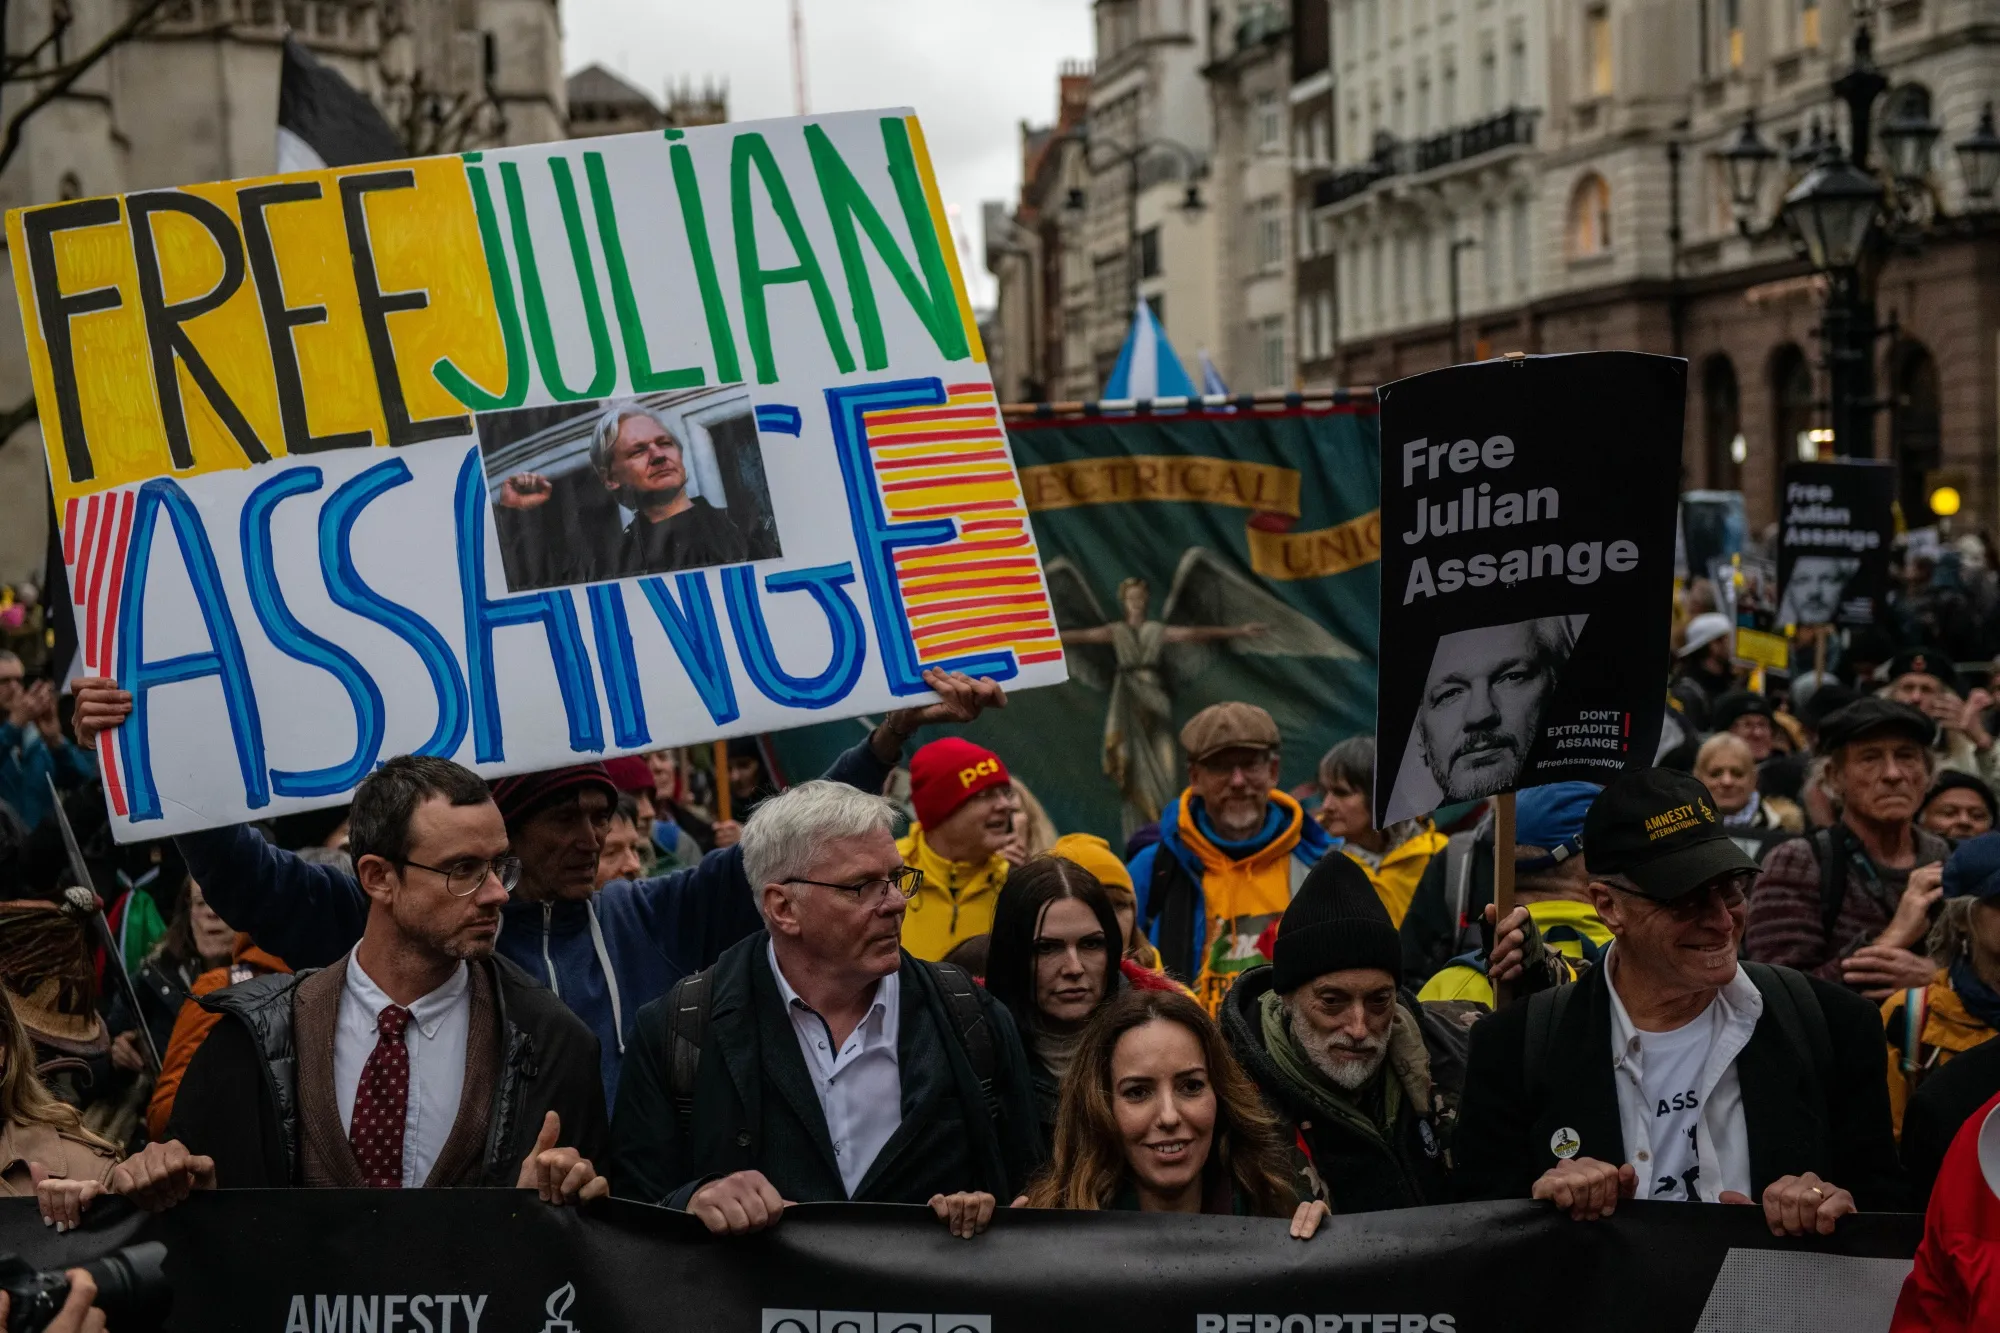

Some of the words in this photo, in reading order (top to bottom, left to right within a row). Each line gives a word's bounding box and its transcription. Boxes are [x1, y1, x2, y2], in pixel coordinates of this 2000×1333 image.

[24, 169, 473, 483] FREE
[1403, 434, 1515, 488] Free
[1036, 460, 1279, 506] ECTRICAL
[1787, 483, 1833, 502] Free
[1402, 482, 1559, 545] Julian
[1786, 505, 1851, 525] Julian
[1784, 527, 1880, 550] Assange
[1403, 538, 1639, 606] Assange
[1579, 710, 1620, 721] DON'T
[1547, 724, 1620, 737] EXTRADITE
[1556, 738, 1619, 750] ASSANGE
[958, 757, 999, 788] pcs
[1537, 757, 1625, 770] #FreeAssangeNOW
[1644, 804, 1695, 832] AMNESTY
[1650, 818, 1702, 841] INTERNATIONAL
[1656, 1089, 1699, 1118] ASS
[285, 1294, 489, 1333] AMNESTY
